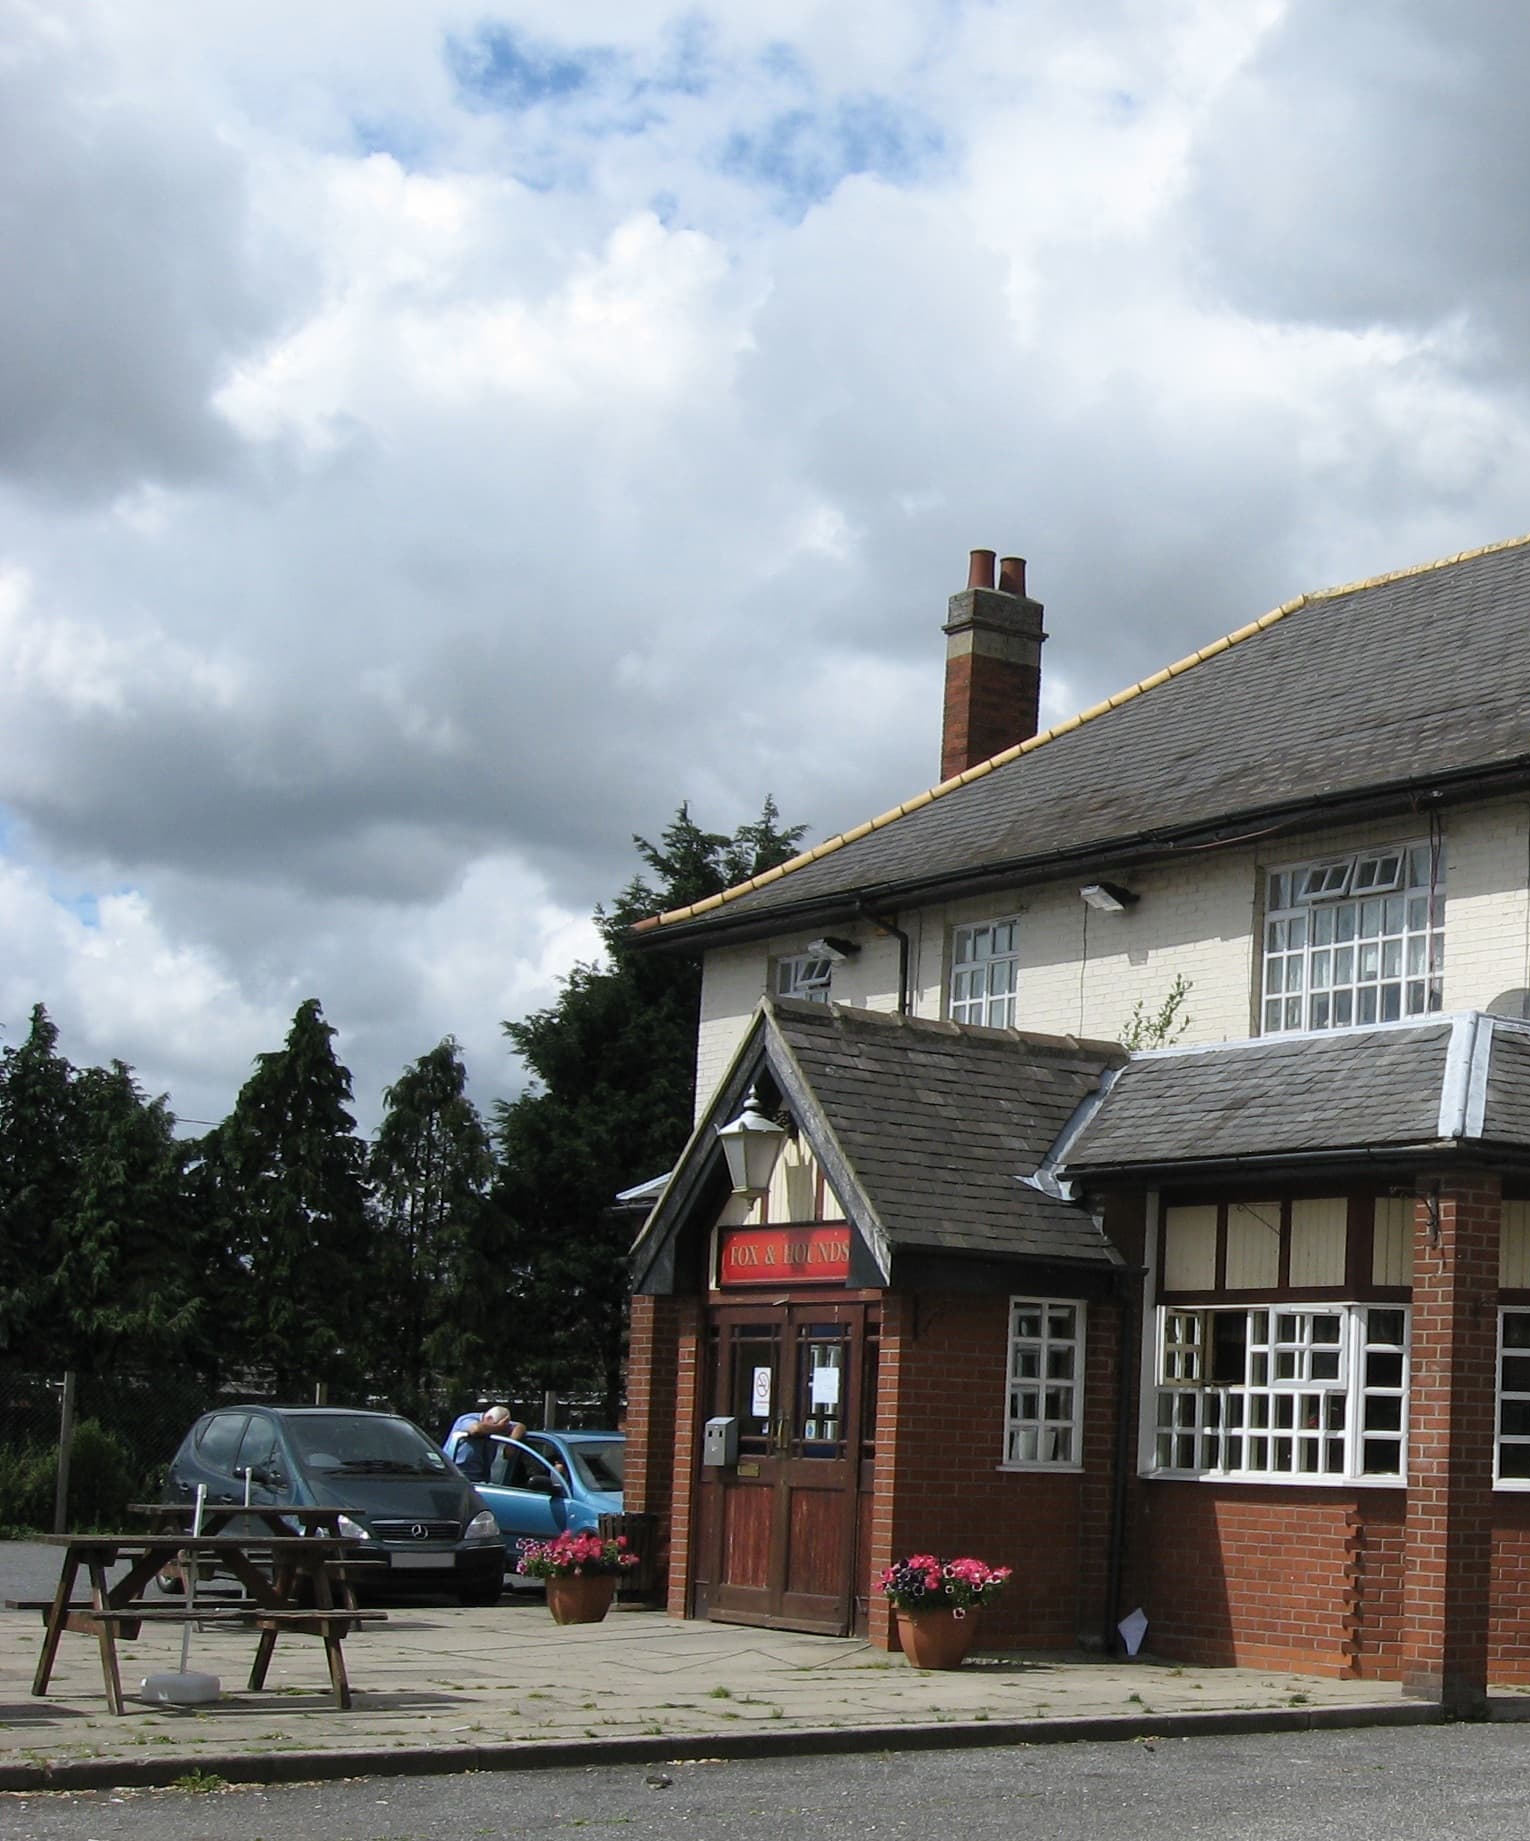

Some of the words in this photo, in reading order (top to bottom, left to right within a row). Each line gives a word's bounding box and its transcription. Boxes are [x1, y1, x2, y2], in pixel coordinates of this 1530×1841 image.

[730, 1246, 759, 1267] FOX
[765, 1246, 775, 1265] &
[784, 1240, 849, 1264] HOUNDS
